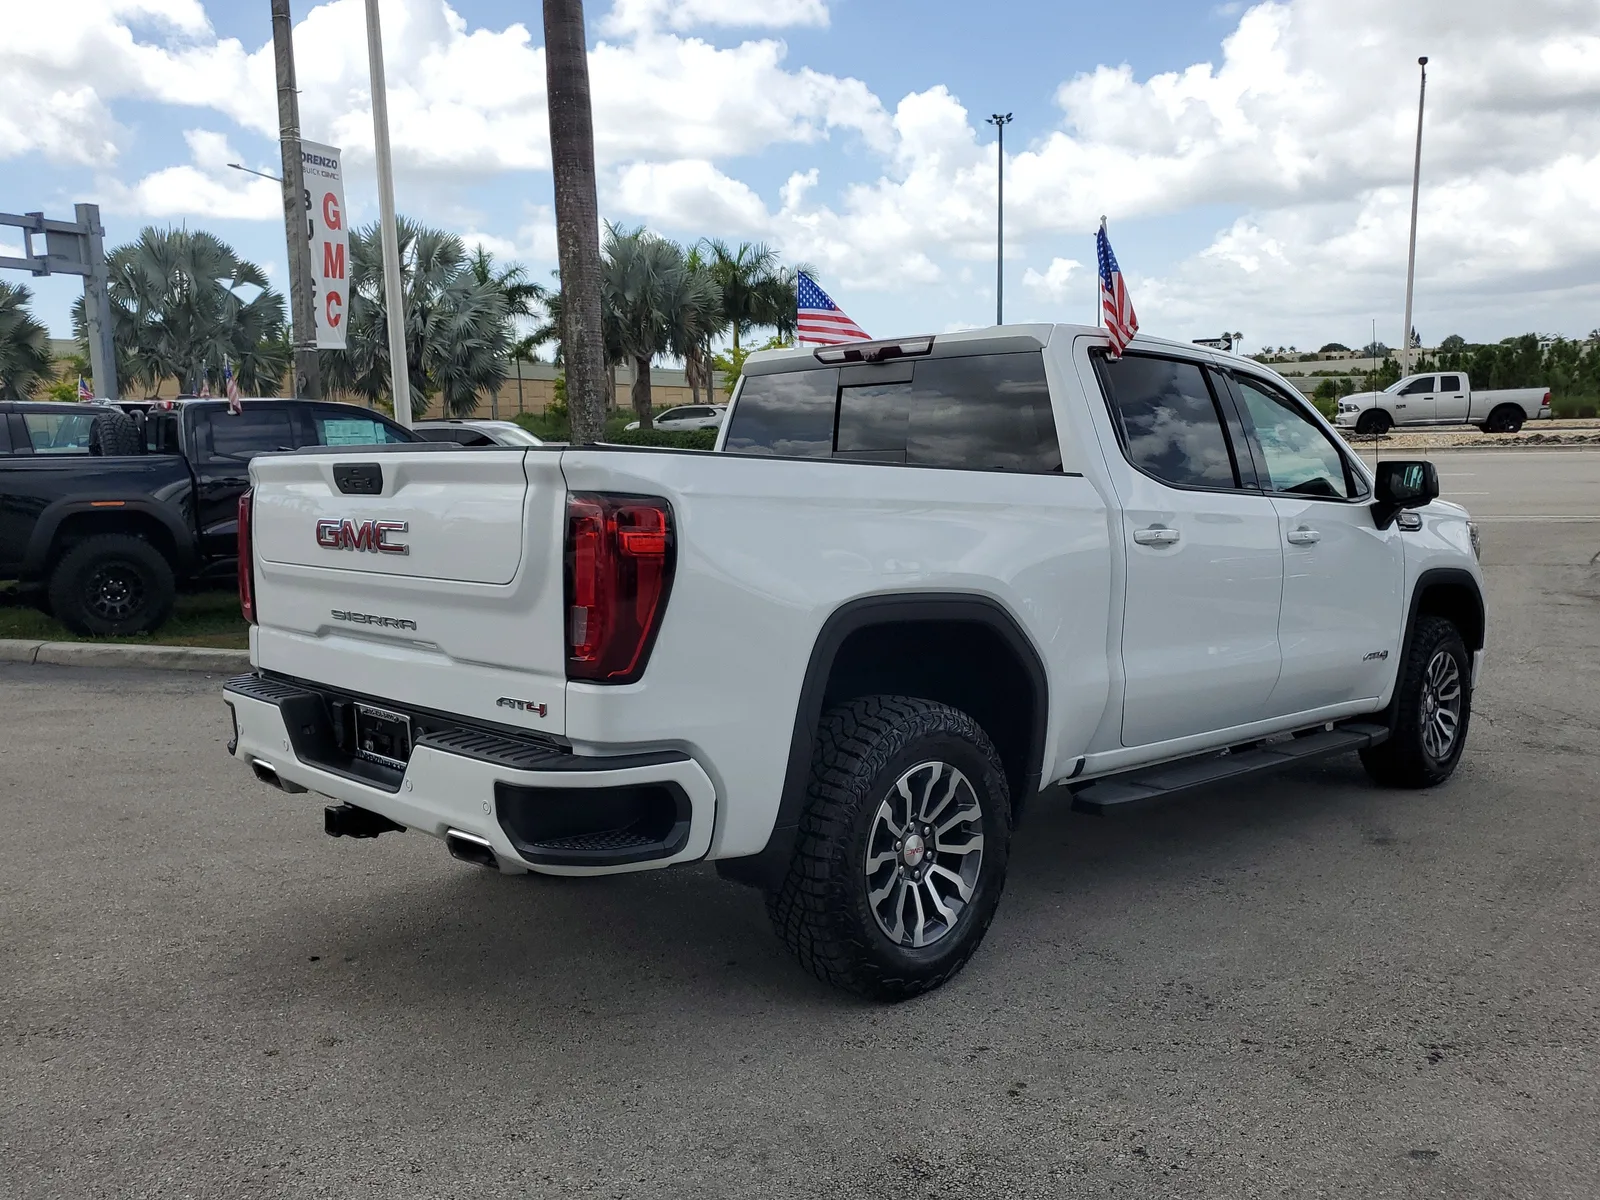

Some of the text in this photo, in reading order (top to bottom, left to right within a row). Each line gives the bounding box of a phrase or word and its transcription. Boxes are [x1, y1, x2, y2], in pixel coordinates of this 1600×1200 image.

[301, 152, 338, 169] ORENZO
[321, 170, 339, 181] GMC
[323, 192, 344, 328] GMC
[316, 518, 409, 556] GMC
[331, 609, 417, 631] SIERRA
[496, 697, 548, 718] AT4
